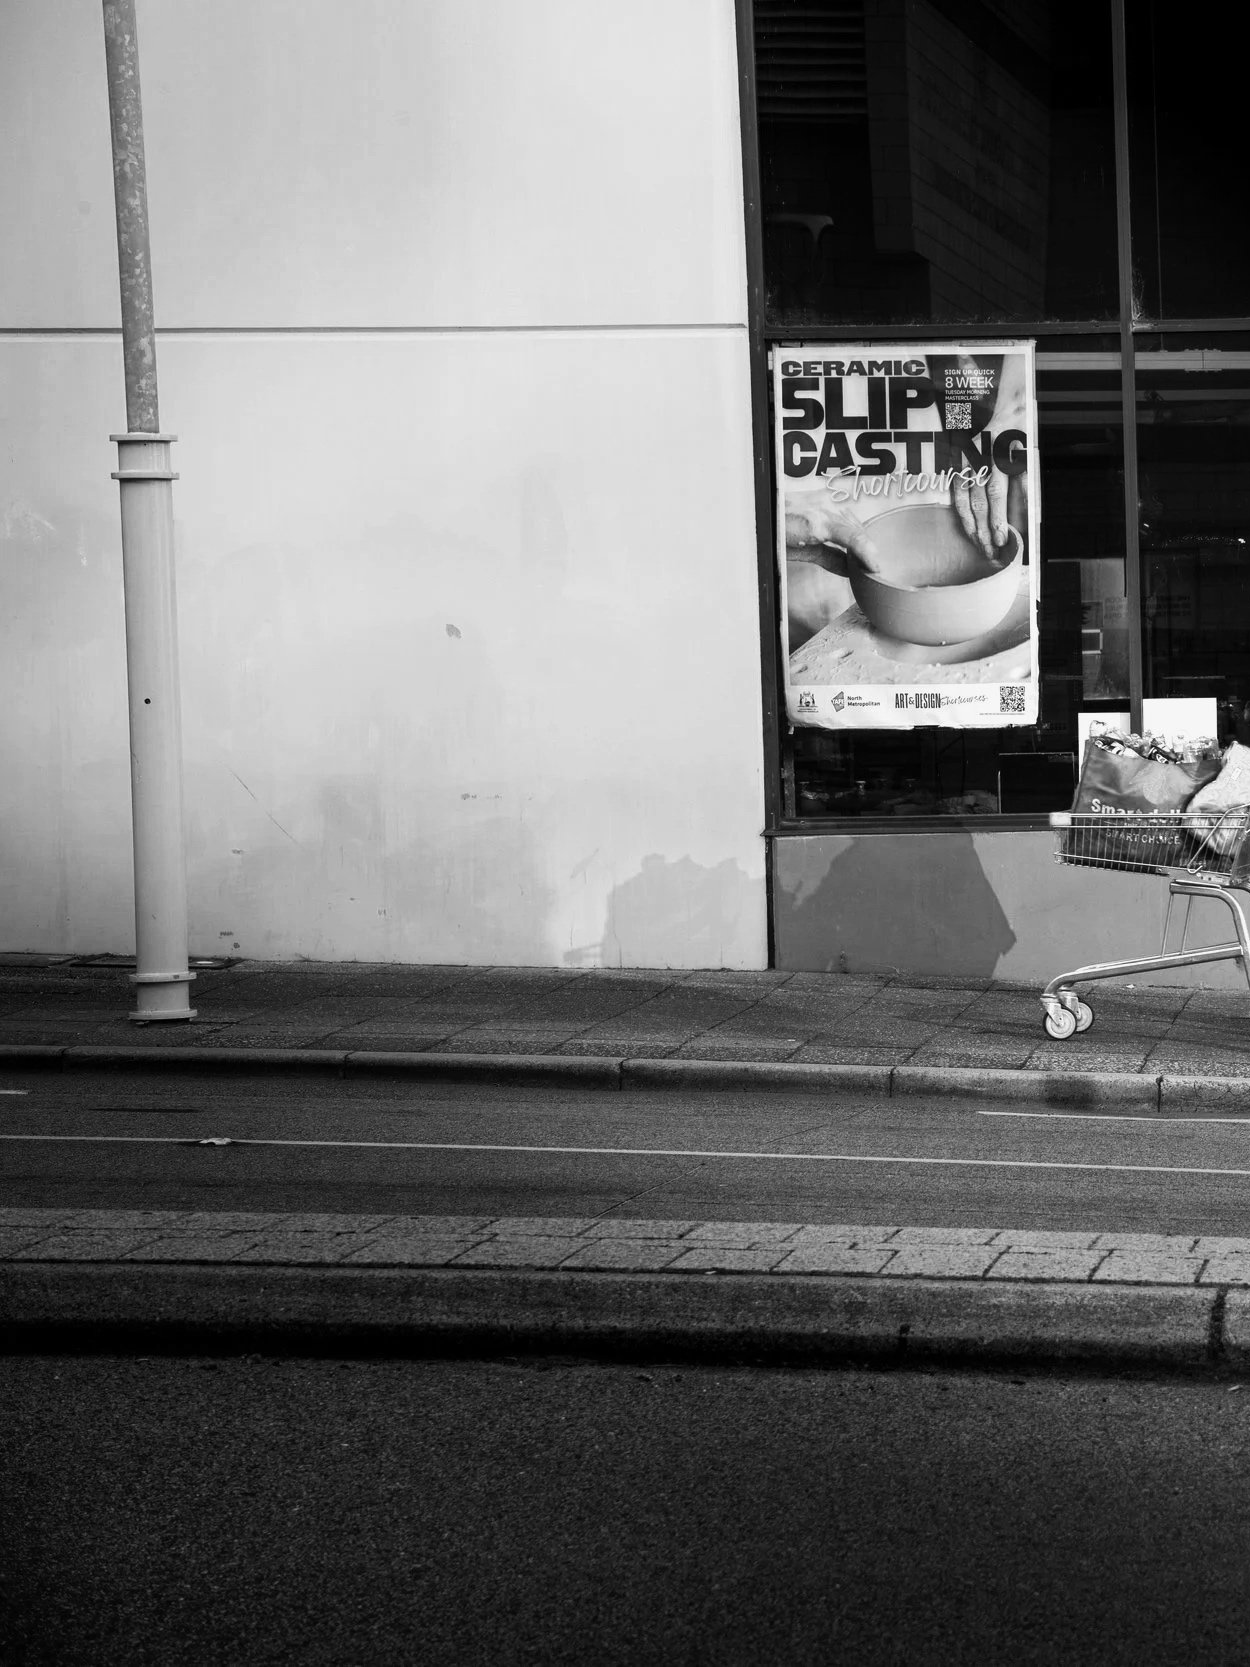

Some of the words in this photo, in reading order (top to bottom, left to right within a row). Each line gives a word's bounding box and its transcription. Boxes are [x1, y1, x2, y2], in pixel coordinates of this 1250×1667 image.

[781, 360, 926, 377] CERAMIC
[973, 369, 995, 377] QUICK
[945, 376, 953, 389] 8
[955, 376, 994, 389] WEEK
[782, 377, 936, 431] SLIP
[783, 429, 1027, 478] CASTING
[820, 464, 993, 502] Shortcourse
